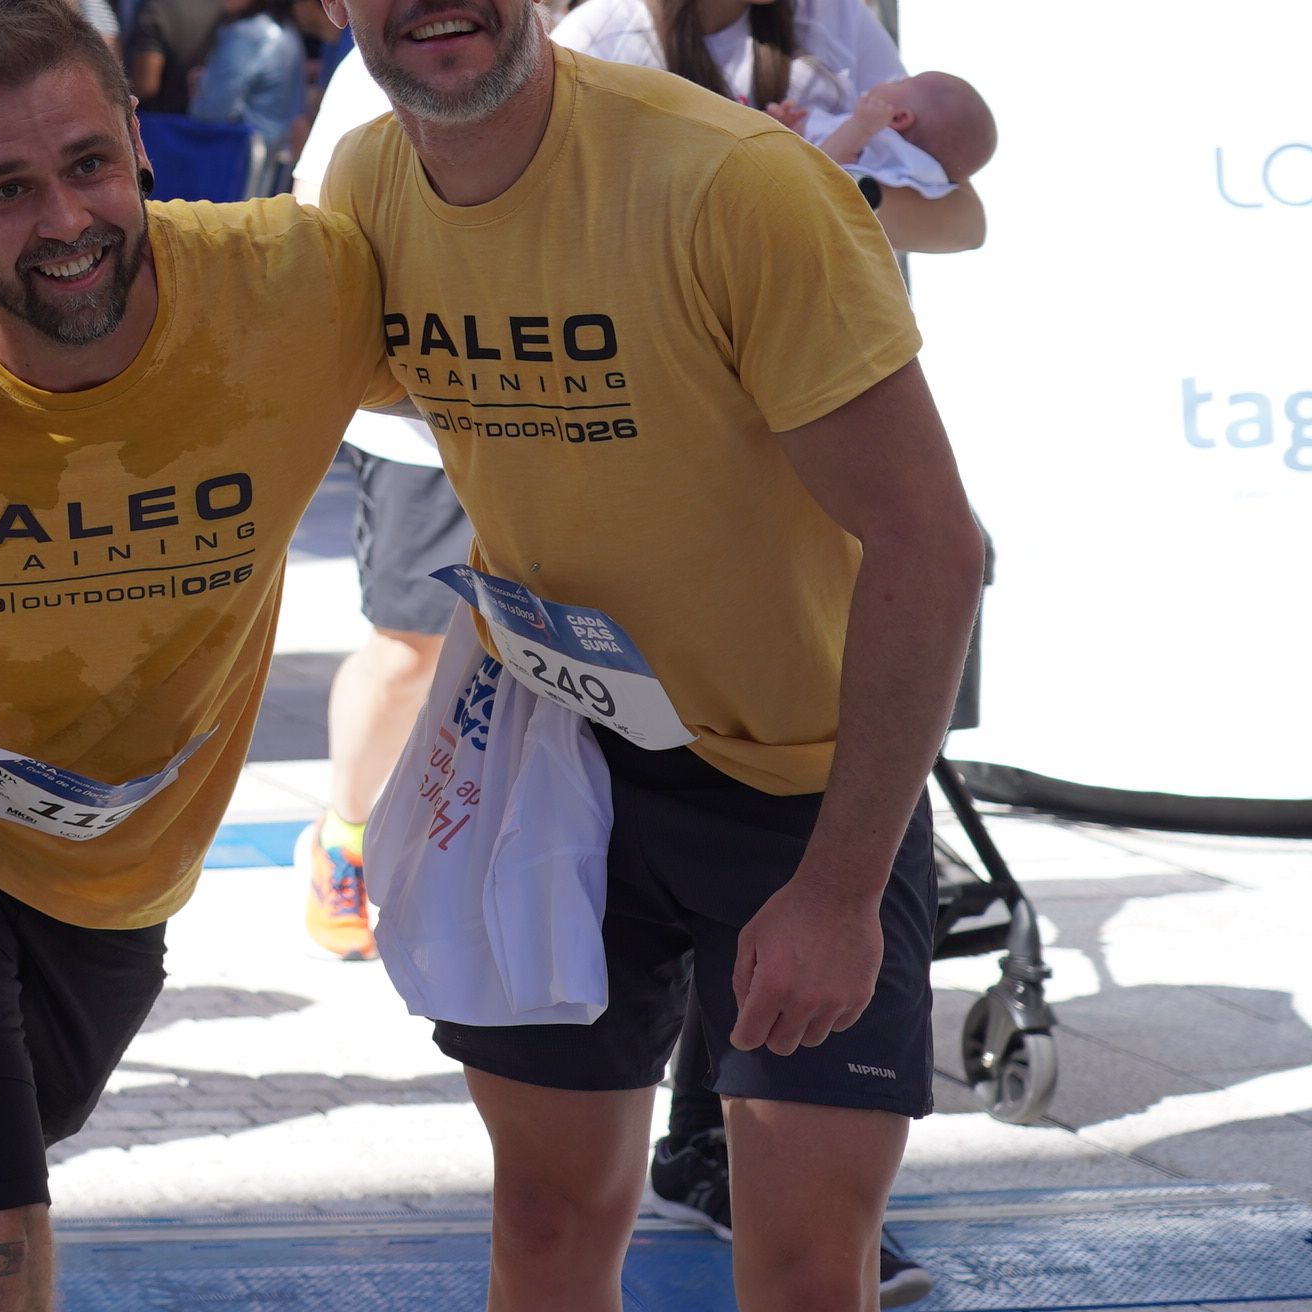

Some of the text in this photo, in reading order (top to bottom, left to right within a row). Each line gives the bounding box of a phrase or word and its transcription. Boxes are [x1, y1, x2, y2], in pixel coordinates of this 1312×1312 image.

[384, 313, 618, 362] PALEO
[566, 614, 609, 629] CADA
[572, 625, 616, 641] PAS
[580, 638, 624, 654] SUMA
[523, 649, 616, 718] 249
[848, 1063, 897, 1080] KIPRUN
